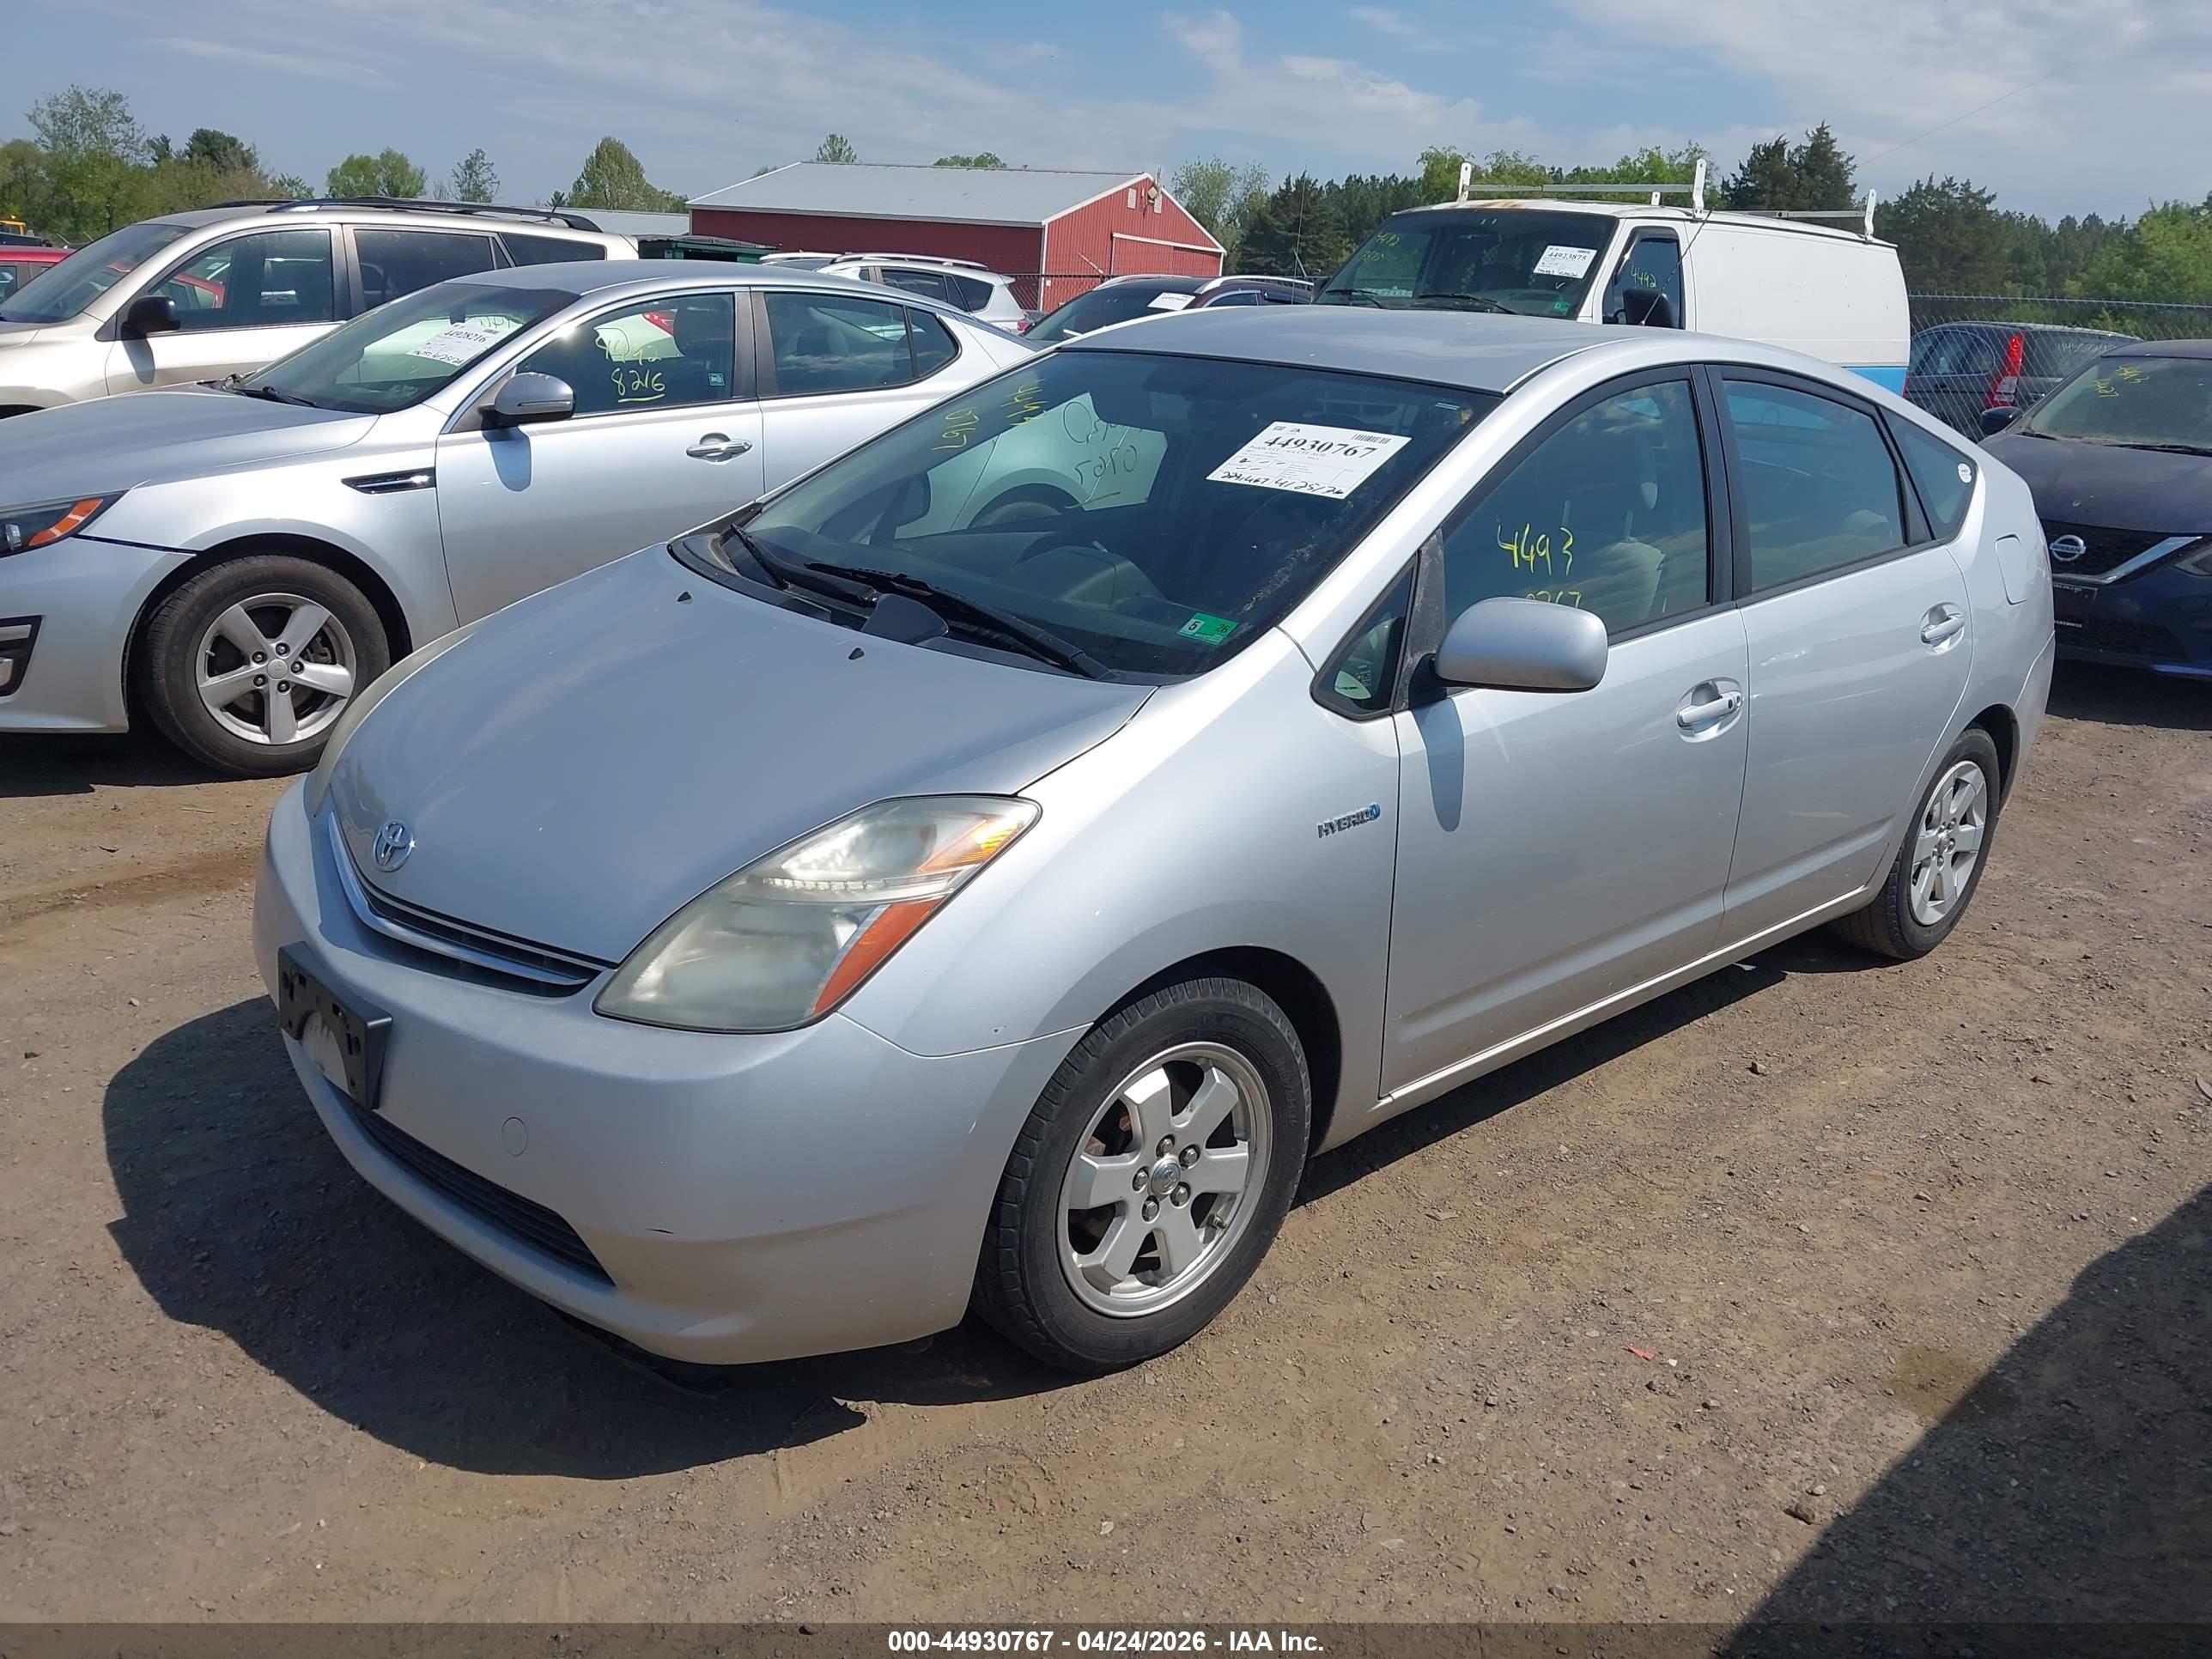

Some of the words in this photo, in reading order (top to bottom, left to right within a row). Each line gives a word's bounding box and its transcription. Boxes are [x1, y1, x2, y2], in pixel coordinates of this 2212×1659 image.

[1631, 264, 1657, 289] 4492
[611, 368, 666, 396] 8216
[1264, 435, 1379, 459] 44930767
[1497, 522, 1574, 577] 4493
[1188, 621, 1200, 631] 5
[1216, 624, 1231, 634] 26
[1317, 809, 1375, 839] HYBRID
